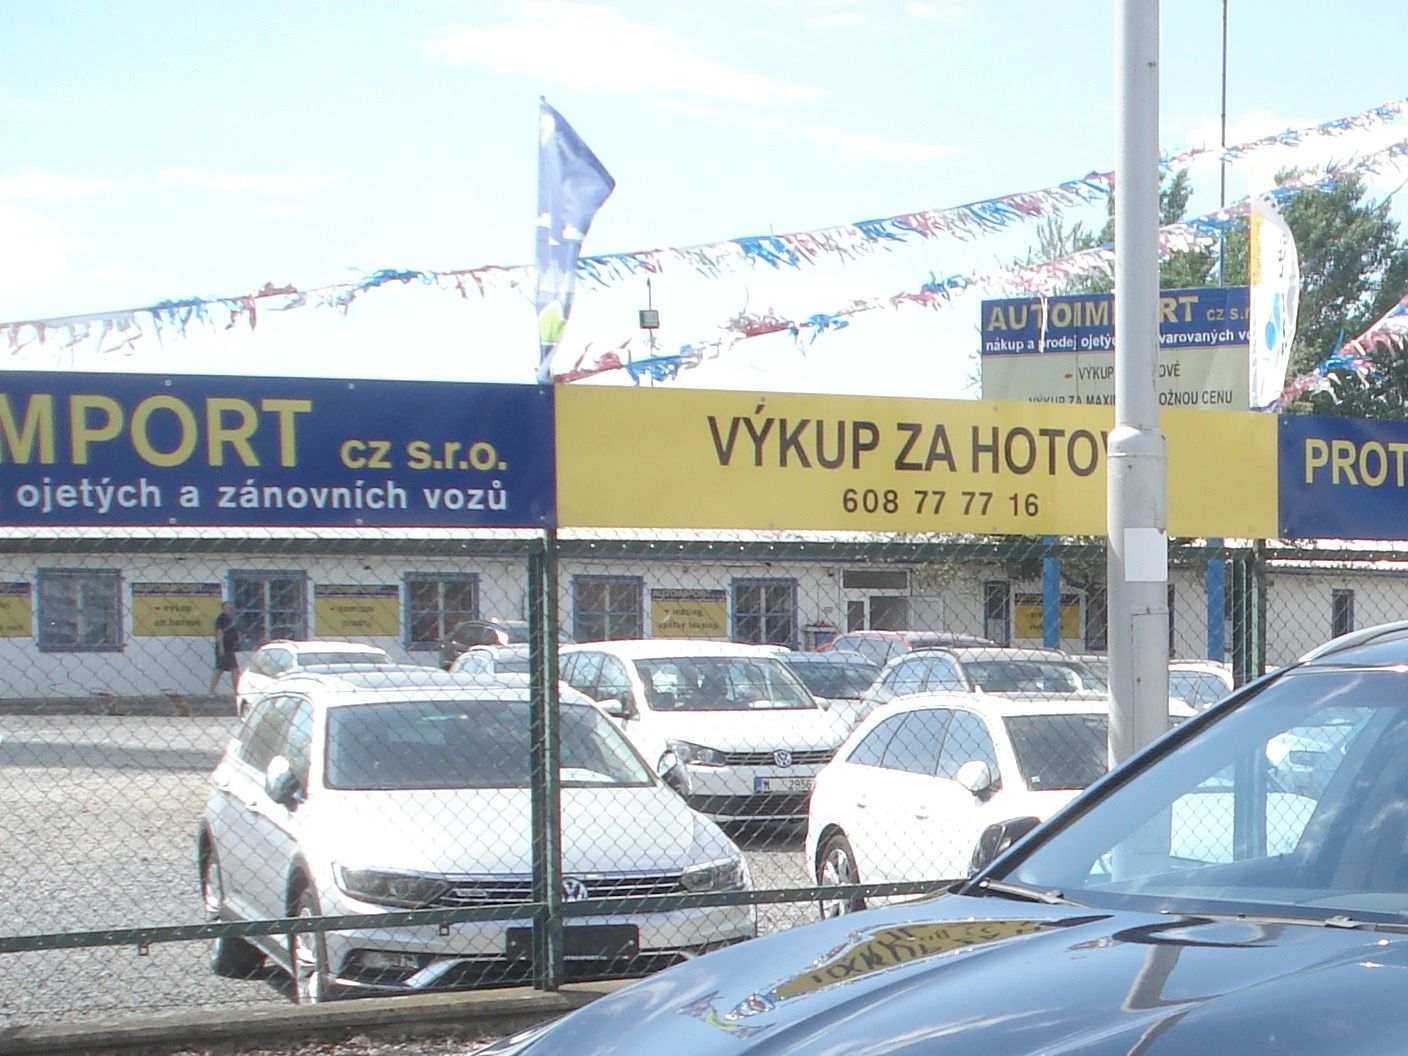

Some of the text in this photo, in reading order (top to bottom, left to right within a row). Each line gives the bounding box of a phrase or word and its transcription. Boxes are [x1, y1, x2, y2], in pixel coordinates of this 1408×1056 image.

[987, 296, 1199, 331] AUTOIMRT
[1206, 308, 1225, 321] cz
[986, 339, 1024, 353] nákup
[1027, 341, 1035, 350] a
[1158, 329, 1235, 347] varovaných
[1079, 364, 1115, 381] VÝKUP
[1158, 389, 1199, 405] OŽNOU
[1201, 391, 1233, 404] CENU
[0, 393, 508, 471] MPORT cz s.r.o.
[706, 403, 1107, 477] VÝKUP ZA HOTO
[17, 476, 508, 514] ojetých a zánovních vozů
[842, 487, 1040, 519] 608 77 77 16
